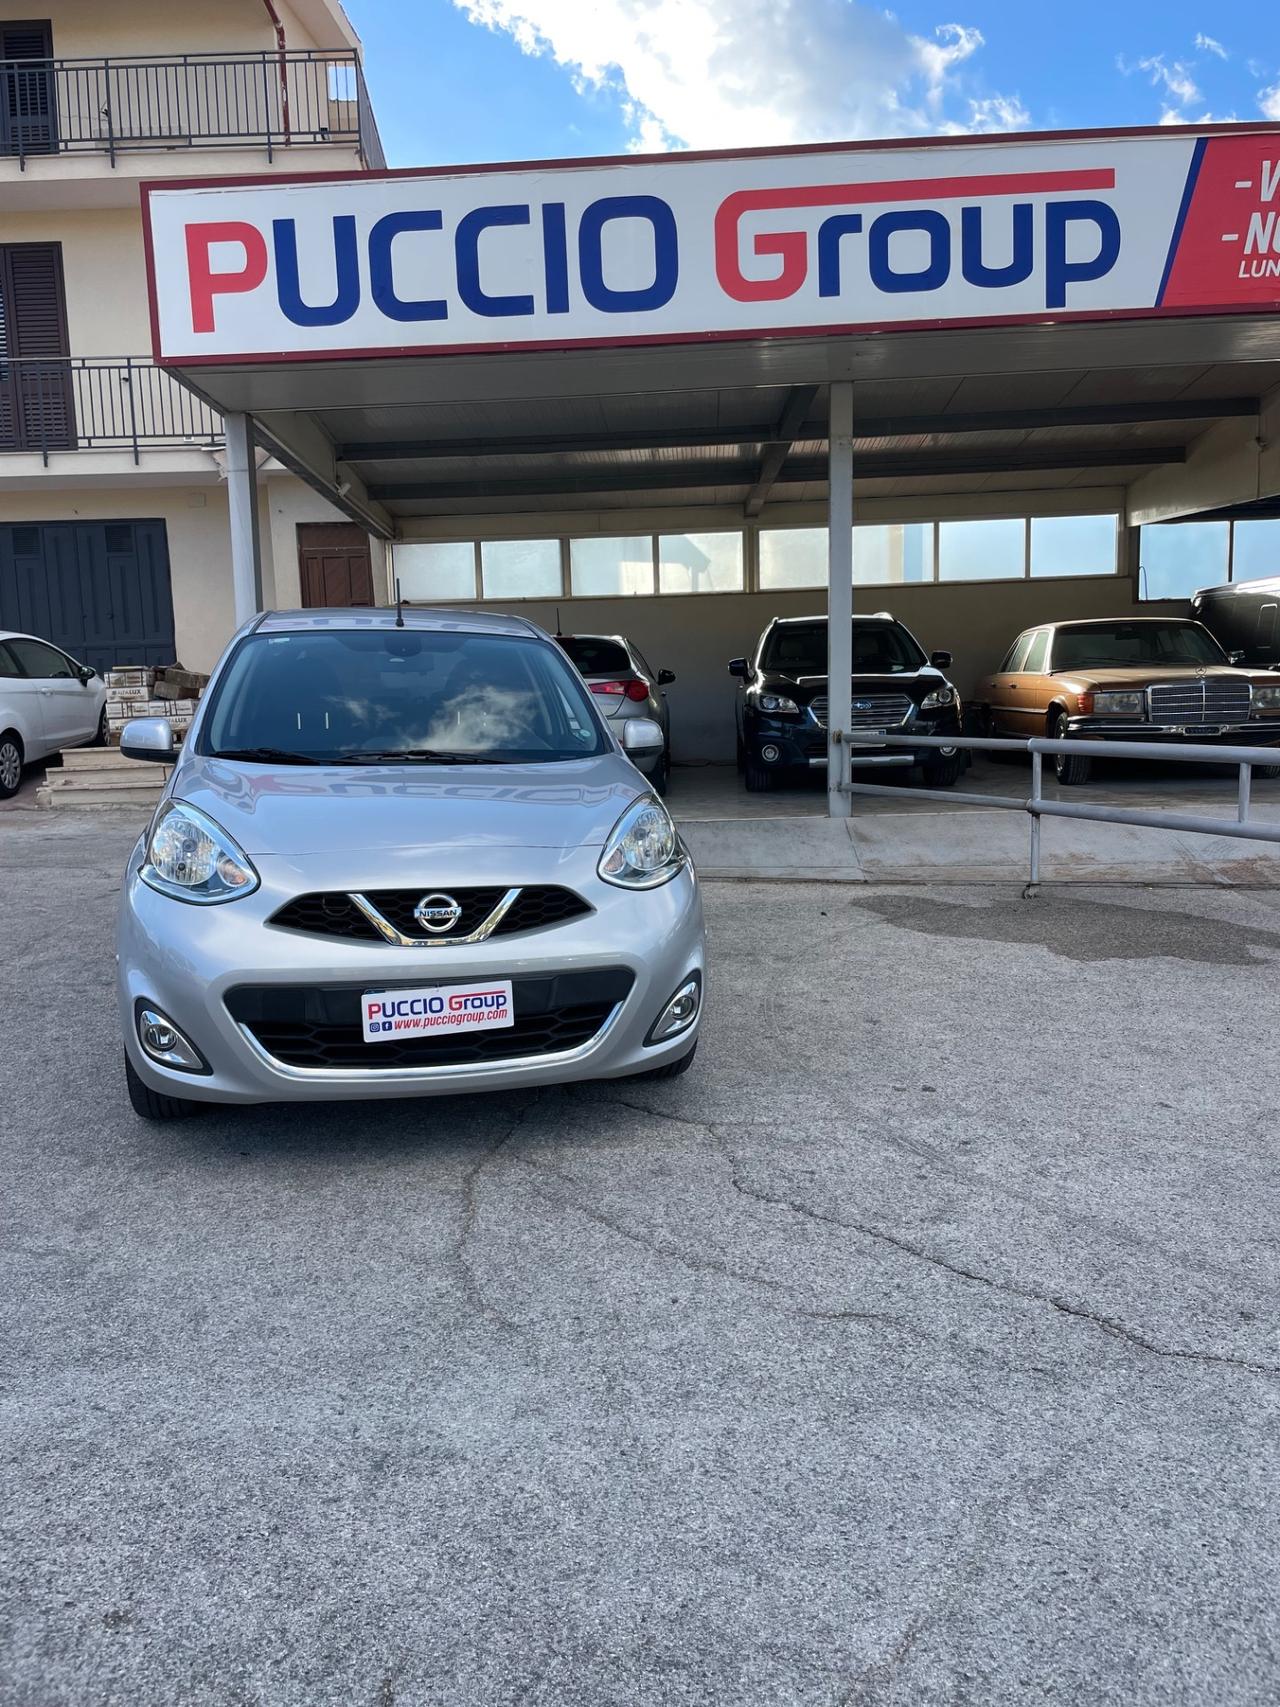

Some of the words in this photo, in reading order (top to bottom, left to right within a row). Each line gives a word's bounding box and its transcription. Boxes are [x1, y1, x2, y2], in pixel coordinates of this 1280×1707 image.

[184, 195, 679, 334] PUCCIO
[714, 167, 1121, 309] Group
[419, 909, 457, 917] NISSAN
[368, 996, 444, 1020] PUCCIO
[394, 1008, 507, 1030] www.pucciogroup.com
